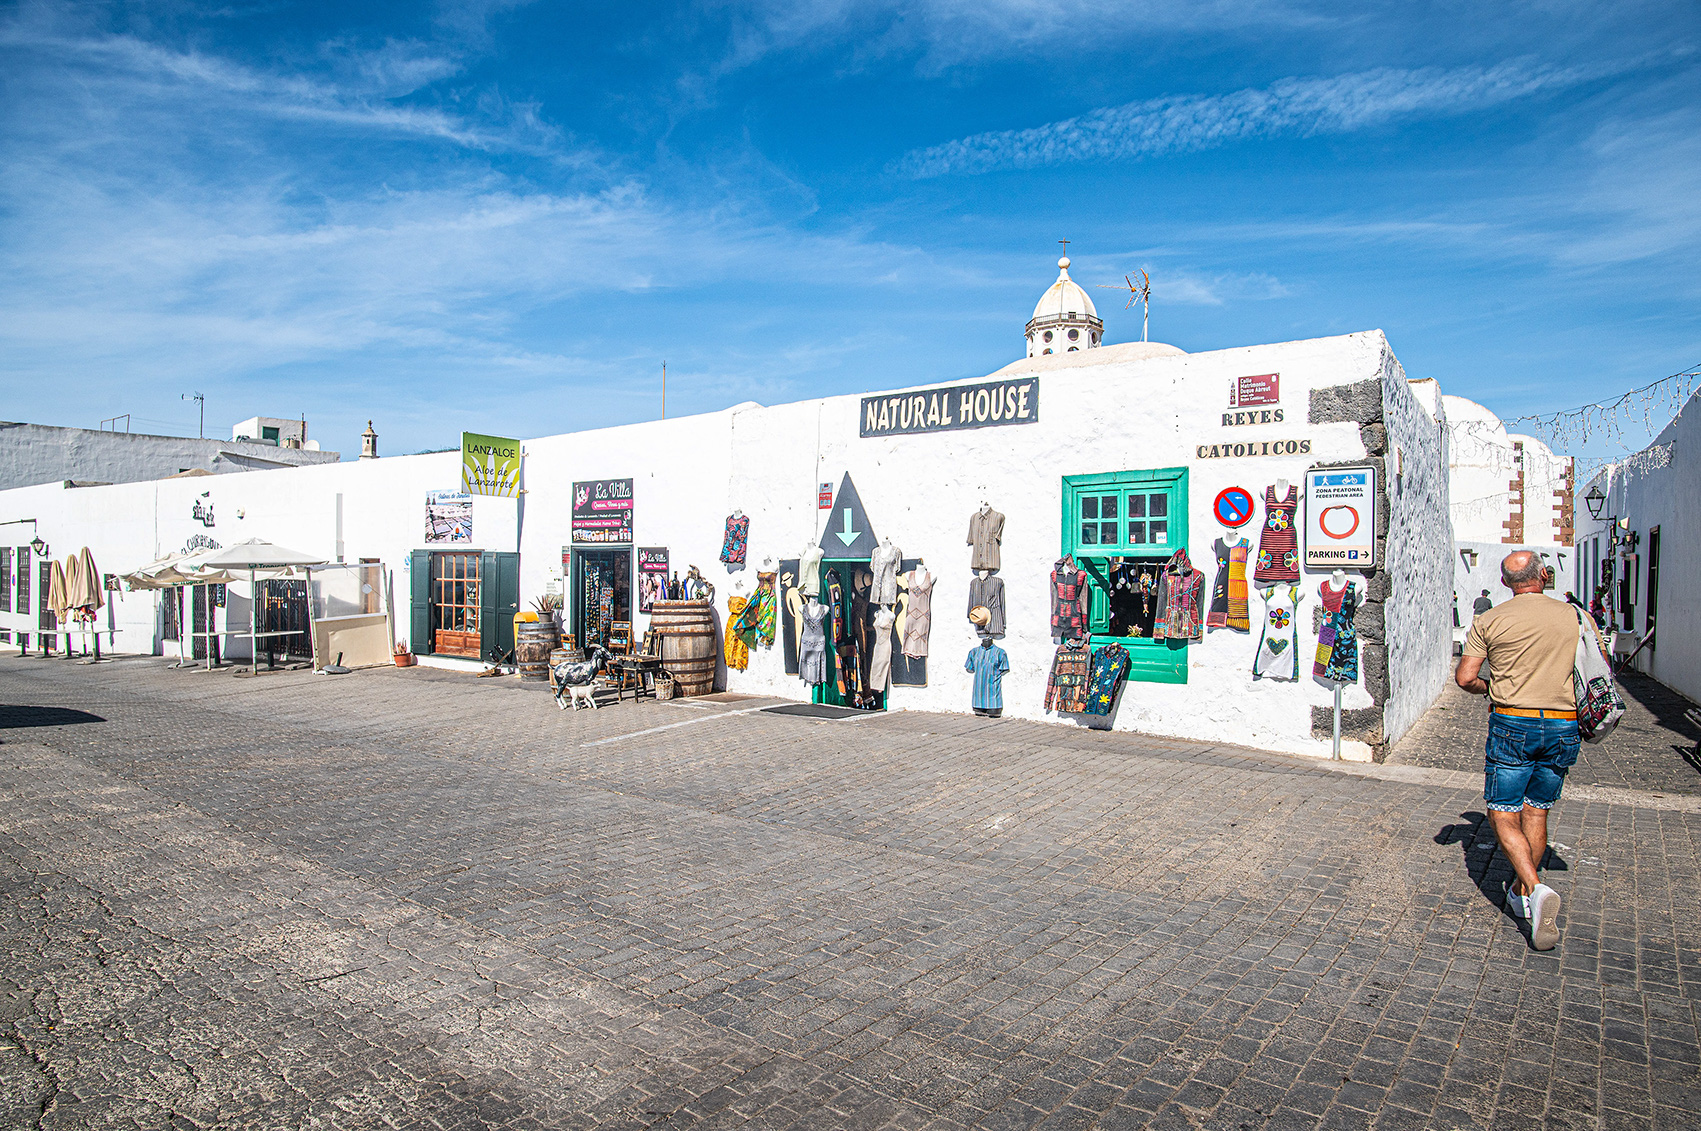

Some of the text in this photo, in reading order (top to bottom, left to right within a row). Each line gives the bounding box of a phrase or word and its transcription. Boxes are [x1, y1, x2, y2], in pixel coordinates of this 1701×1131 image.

[865, 383, 1032, 432] NATURAL HOUSE
[1221, 408, 1284, 427] REYES
[467, 443, 515, 459] LANZALOE
[1197, 438, 1311, 460] CATOLICOS
[474, 465, 508, 477] Aloe de
[468, 476, 514, 489] Lanzarote
[595, 481, 632, 499] La Villa
[1308, 550, 1346, 559] PARKING
